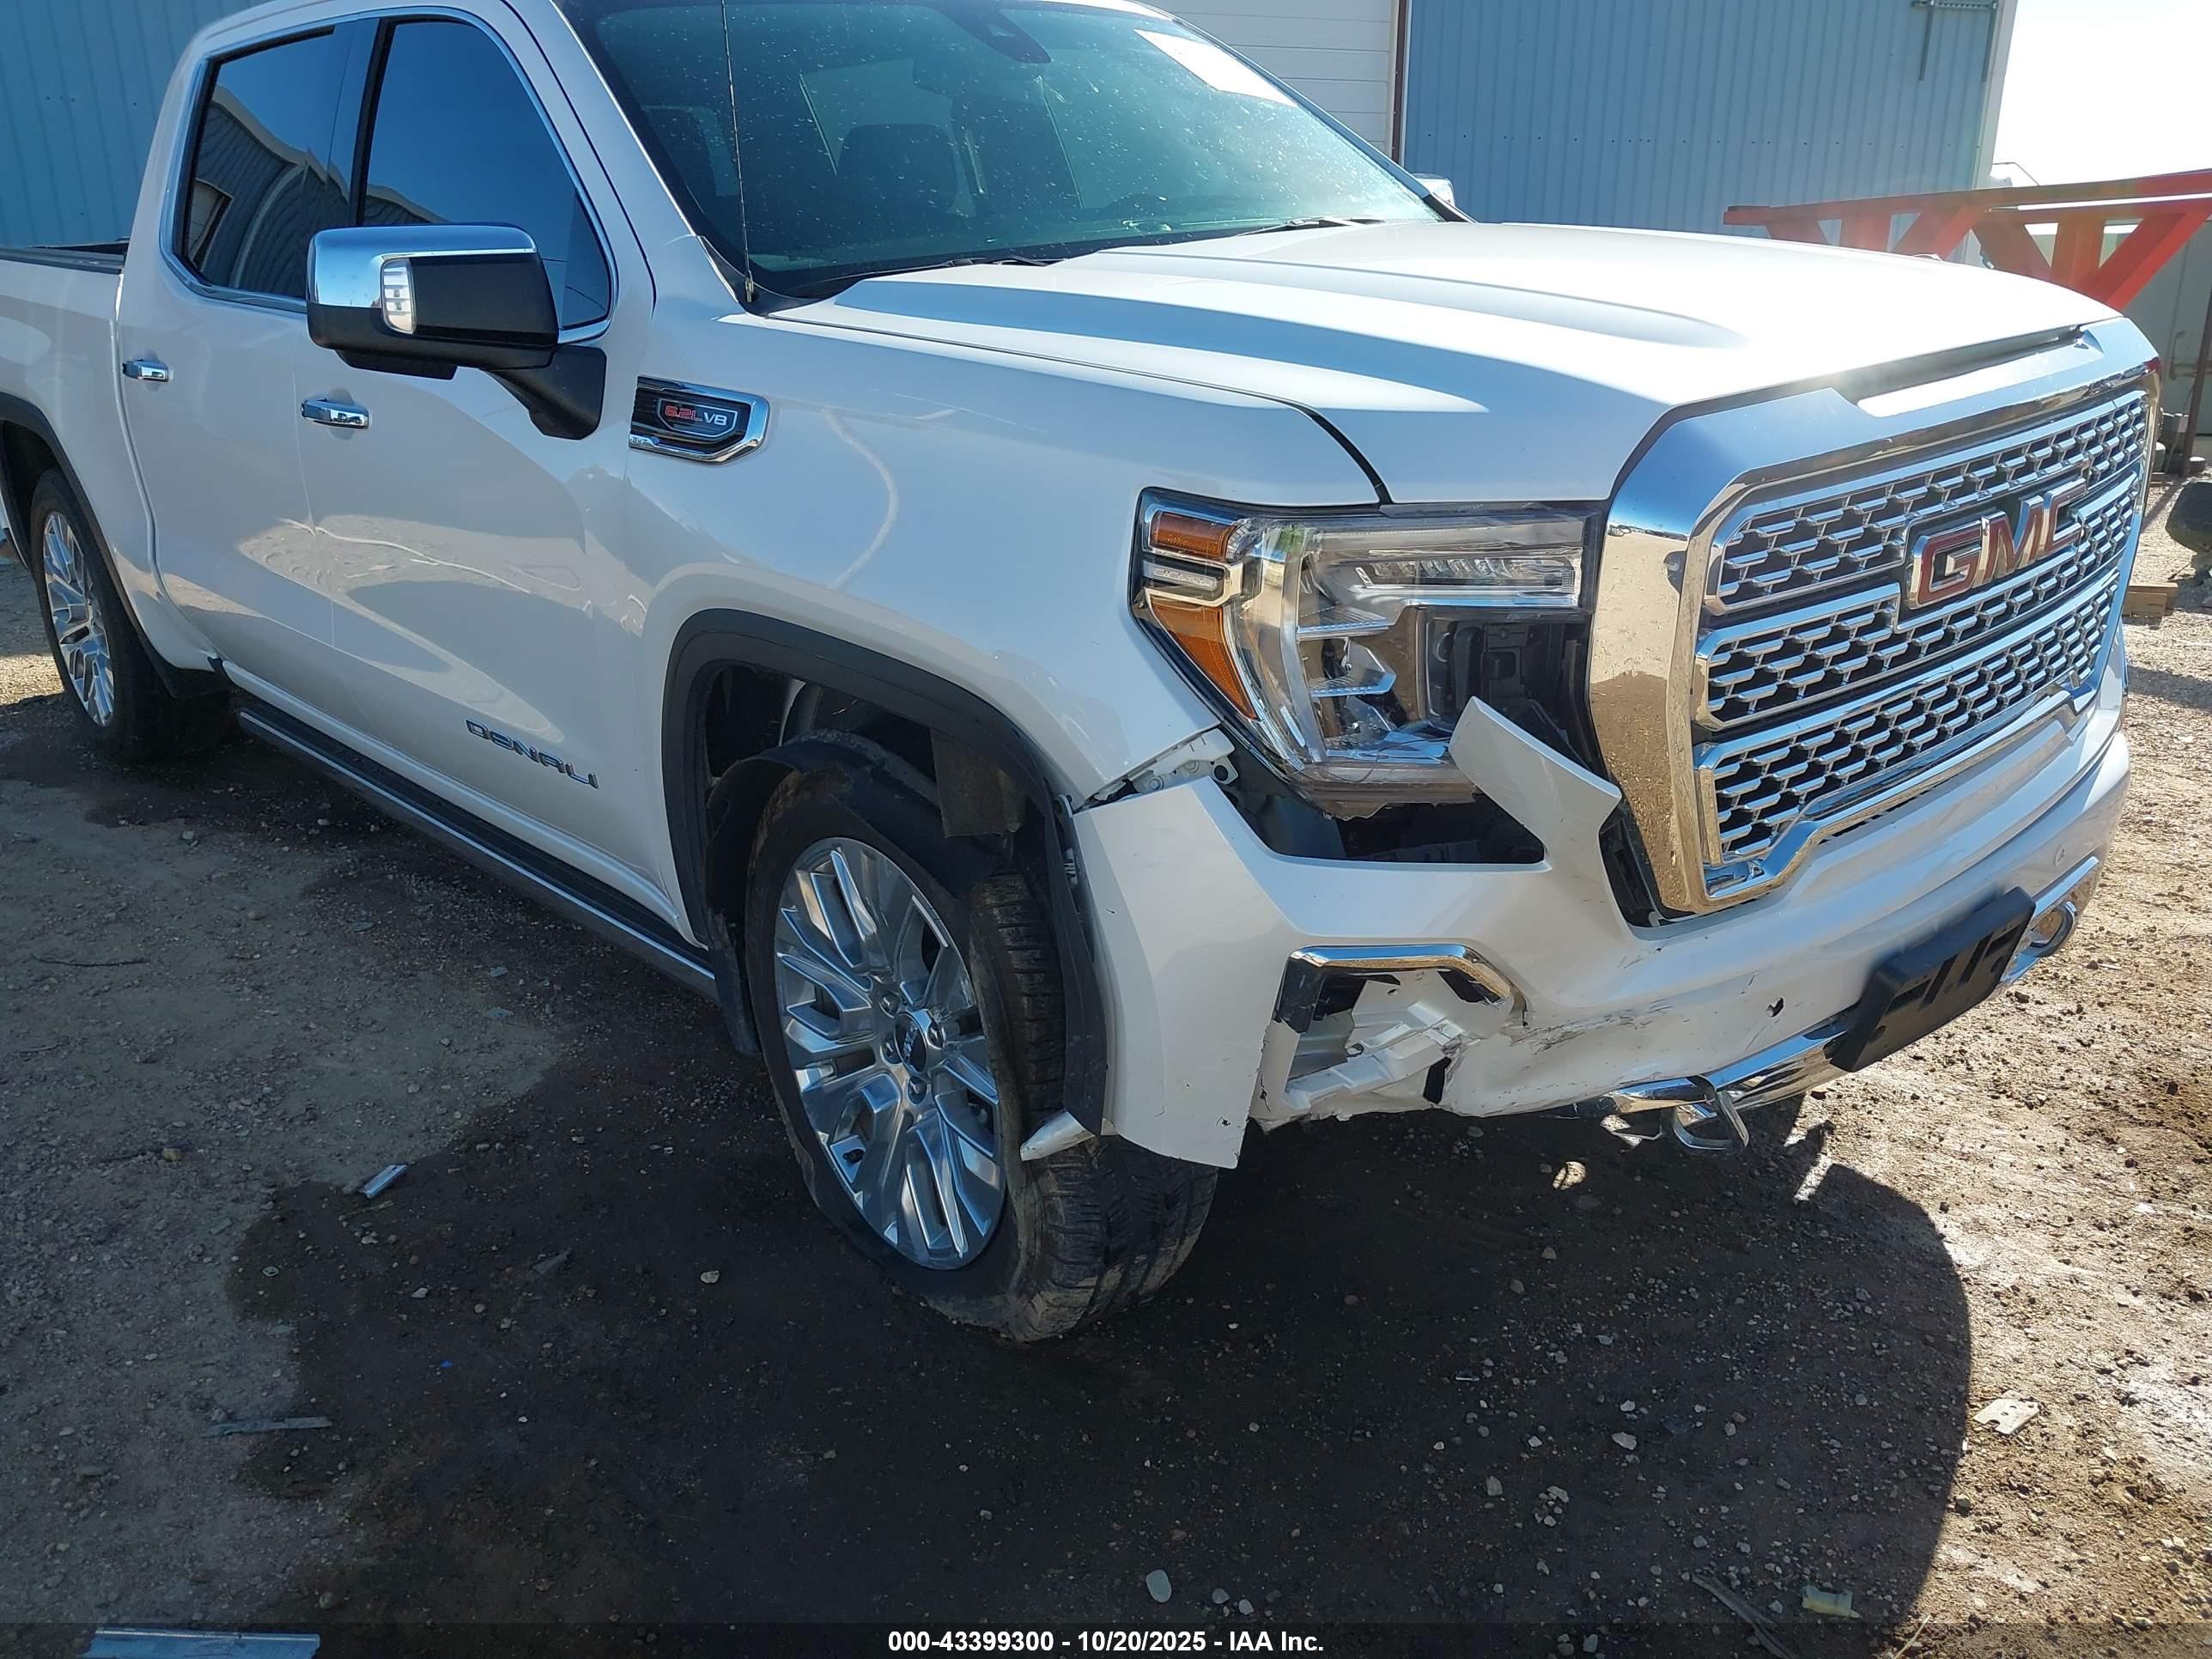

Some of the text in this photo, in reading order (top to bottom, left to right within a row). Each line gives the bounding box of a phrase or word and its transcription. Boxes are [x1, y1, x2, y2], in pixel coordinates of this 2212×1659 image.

[665, 404, 728, 426] 6.2L V8
[1909, 477, 2087, 610] GMC
[465, 717, 599, 789] DENALI
